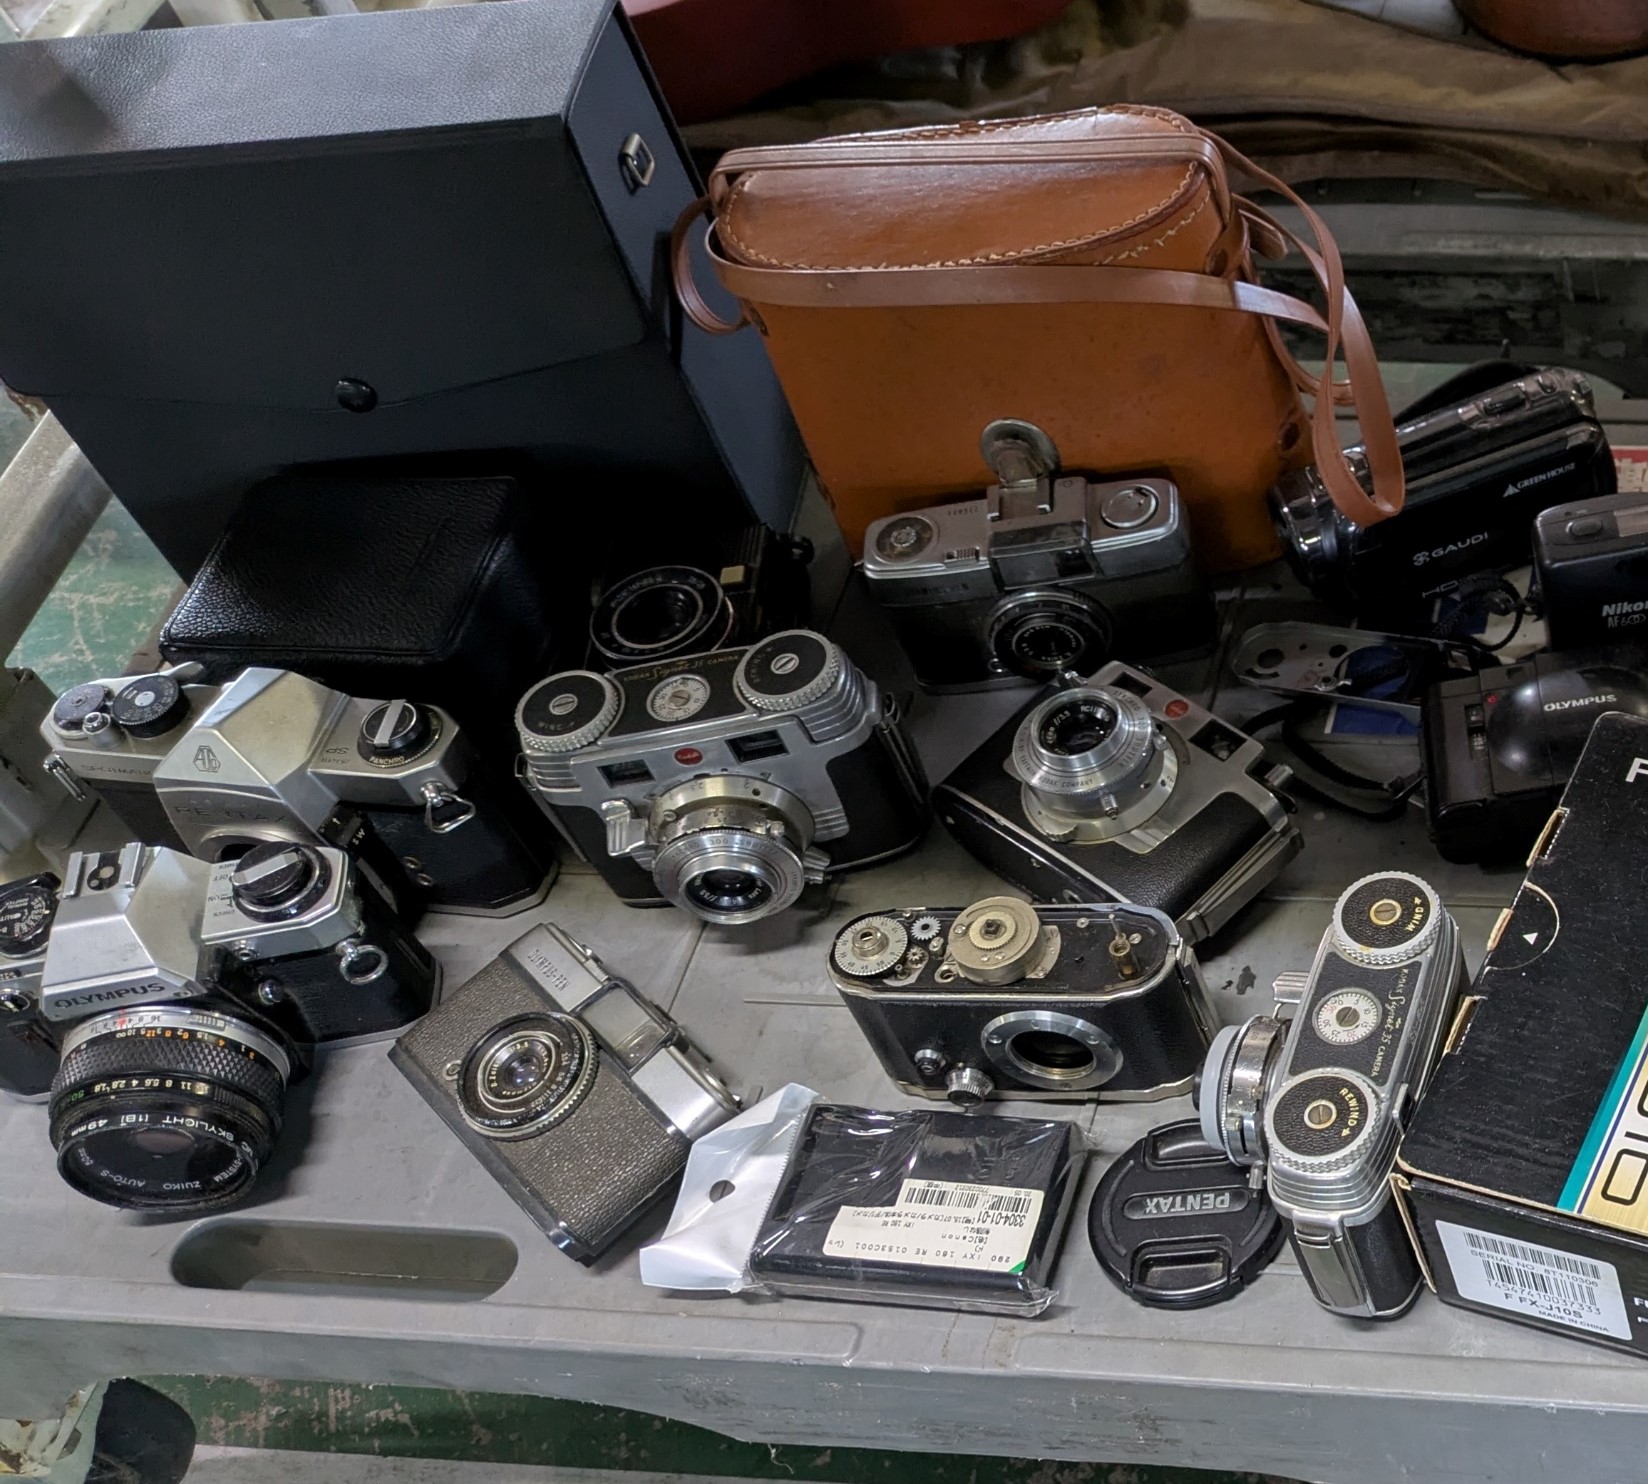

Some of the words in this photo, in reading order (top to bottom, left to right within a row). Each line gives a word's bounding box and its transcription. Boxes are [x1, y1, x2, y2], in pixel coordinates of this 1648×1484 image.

[1431, 532, 1489, 558] GAUDI
[1543, 694, 1617, 712] OLYMPUS
[369, 754, 406, 767] PANCHRO
[1405, 906, 1424, 933] WIND
[54, 982, 166, 1009] OLYMPUS
[1371, 1046, 1387, 1078] CAMERA
[1339, 1086, 1360, 1127] REWIND
[71, 1118, 109, 1137] 49mm
[162, 1115, 235, 1142] SKYLIGHT
[100, 1168, 146, 1189] AUTO-S
[163, 1180, 203, 1191] ZUIKO
[1144, 1192, 1230, 1215] PENTAX
[976, 1210, 1027, 1228] 3304-01-01
[1471, 1248, 1516, 1267] SERIAL
[1486, 1278, 1603, 1317] T4547410037333
[1504, 1291, 1515, 1303] F
[1518, 1296, 1584, 1321] FX-J10S
[1538, 1308, 1567, 1324] MADE
[1567, 1316, 1578, 1326] IN
[1578, 1319, 1610, 1335] CHINA
